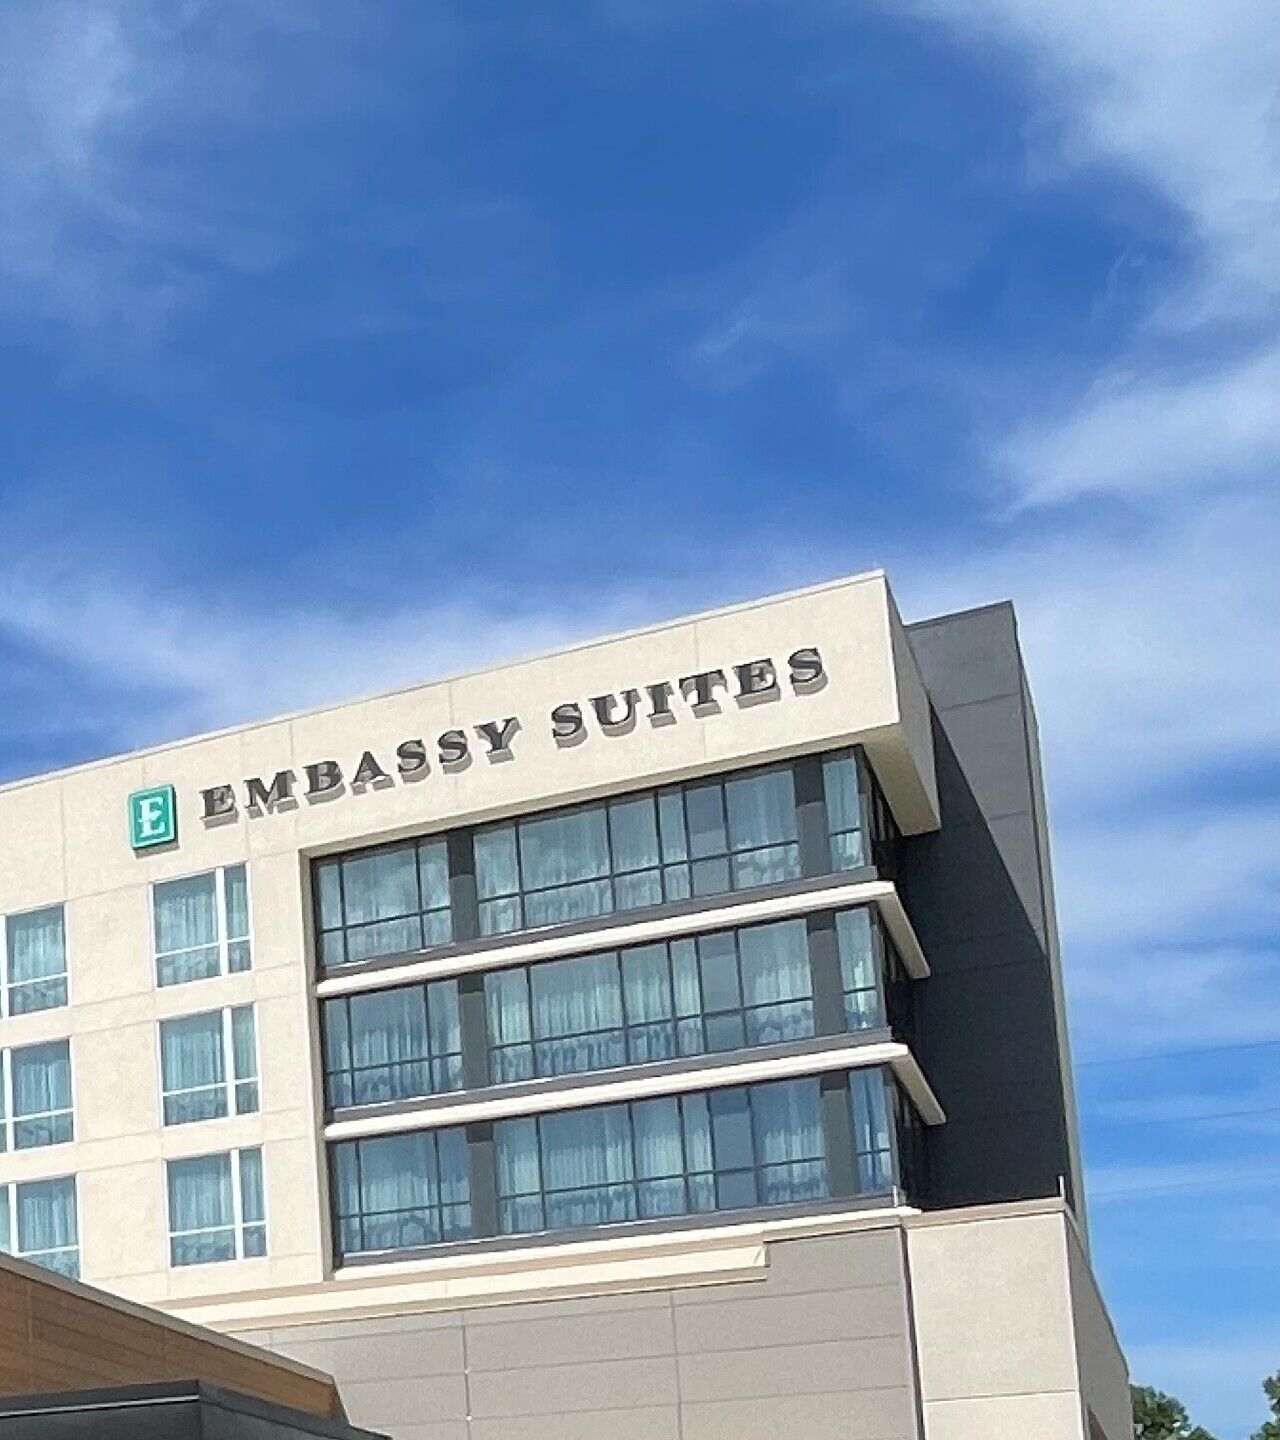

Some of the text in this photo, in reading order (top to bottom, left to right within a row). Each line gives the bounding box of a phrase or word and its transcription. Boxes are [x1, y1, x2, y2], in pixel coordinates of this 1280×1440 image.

[137, 647, 824, 838] E EMBASSY SUITES
